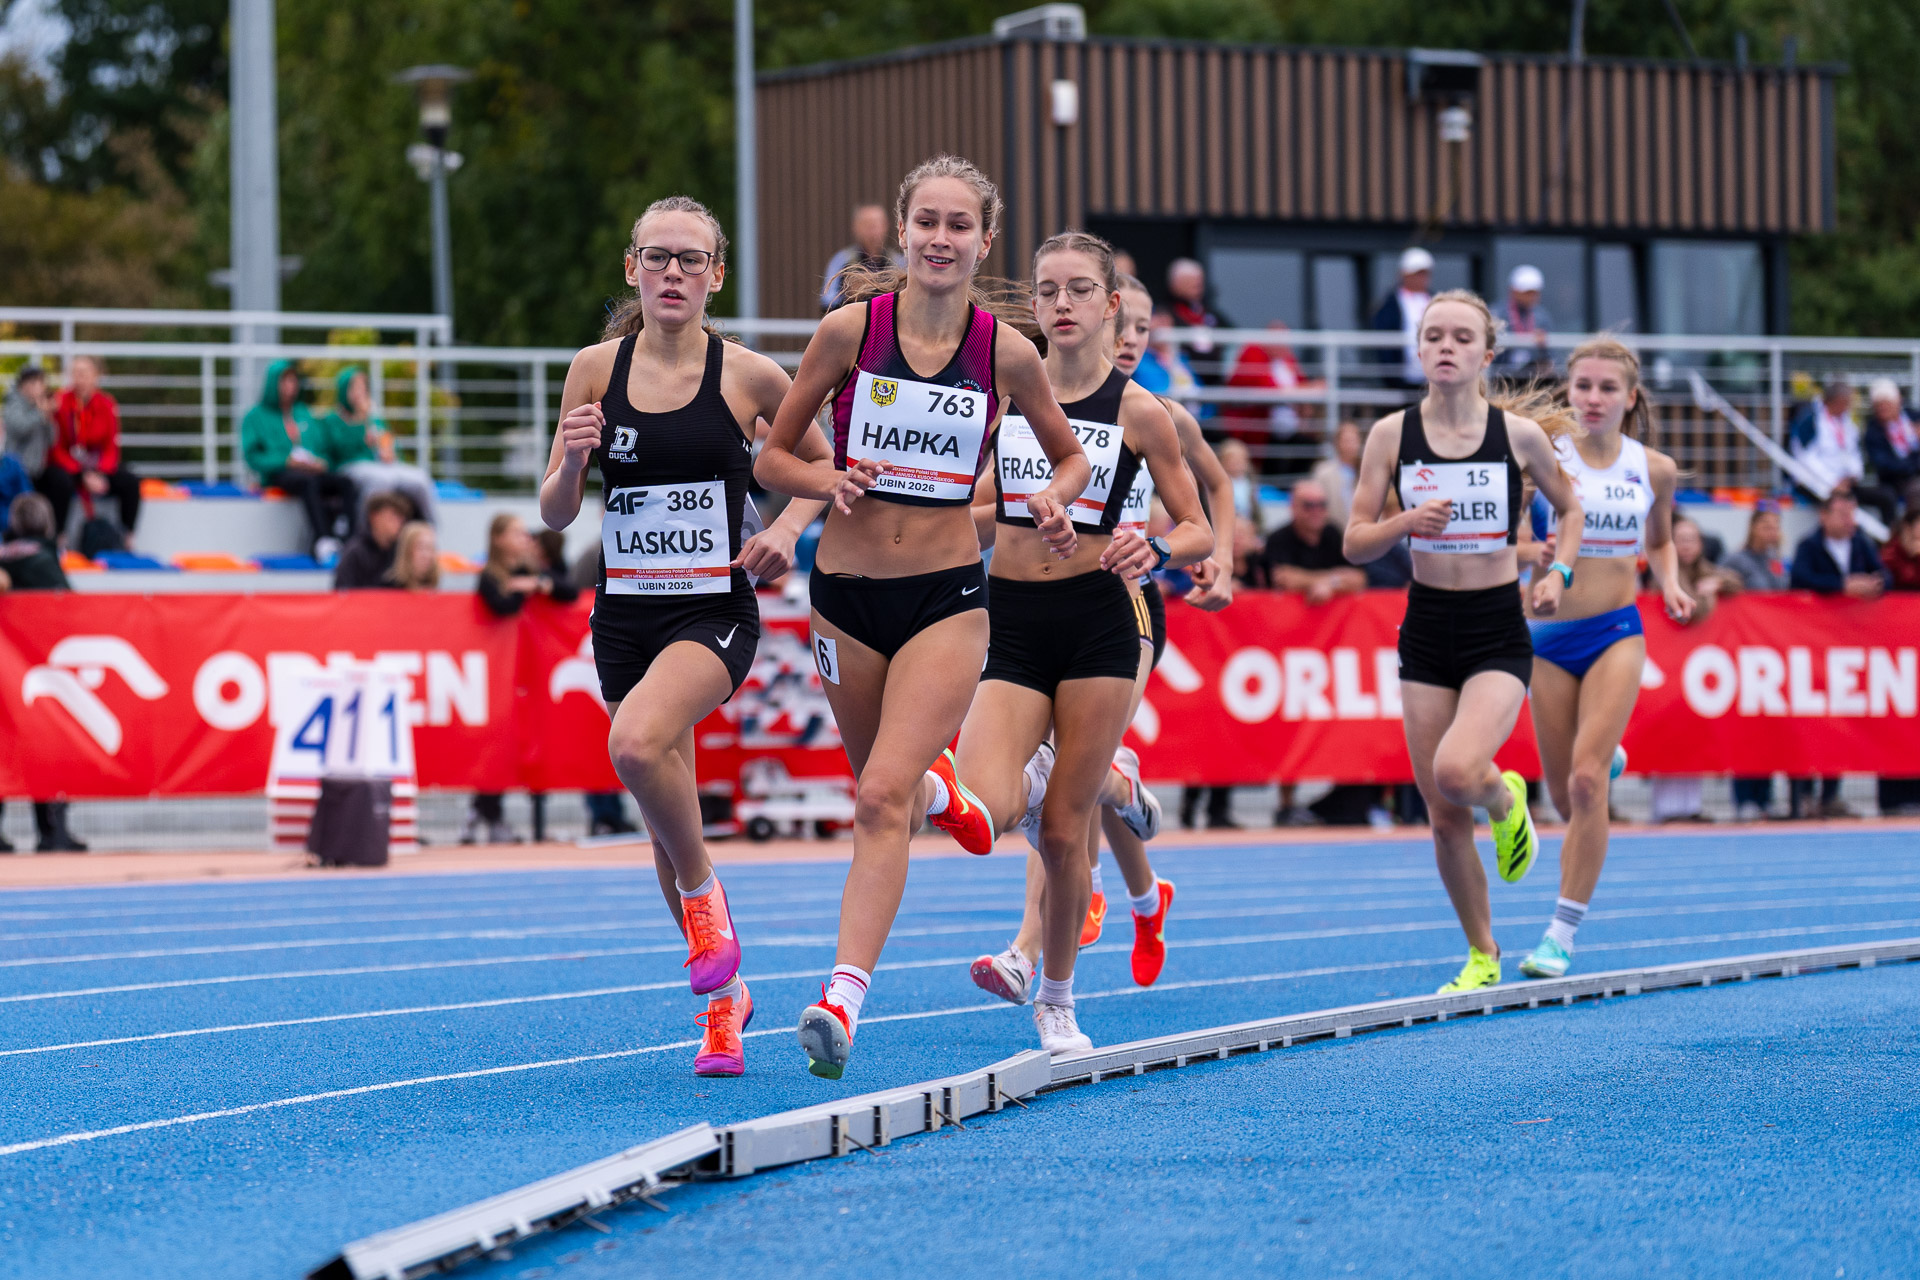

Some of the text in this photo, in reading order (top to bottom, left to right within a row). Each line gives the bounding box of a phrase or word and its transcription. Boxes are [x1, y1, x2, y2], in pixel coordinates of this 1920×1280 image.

[928, 390, 975, 418] 763
[861, 421, 960, 459] HAPKA
[608, 451, 639, 460] DUCLA
[908, 481, 935, 492] 2026
[1467, 470, 1490, 488] 15
[666, 488, 714, 512] 386
[1604, 486, 1636, 500] 104
[1411, 501, 1498, 521] SLER
[1552, 511, 1638, 531] SIAŁA
[615, 528, 714, 555] LASKUS
[638, 581, 694, 591] LUBIN 2026
[818, 638, 832, 678] 6
[1219, 645, 1403, 724] ORLE
[1682, 643, 1919, 719] ORLEN
